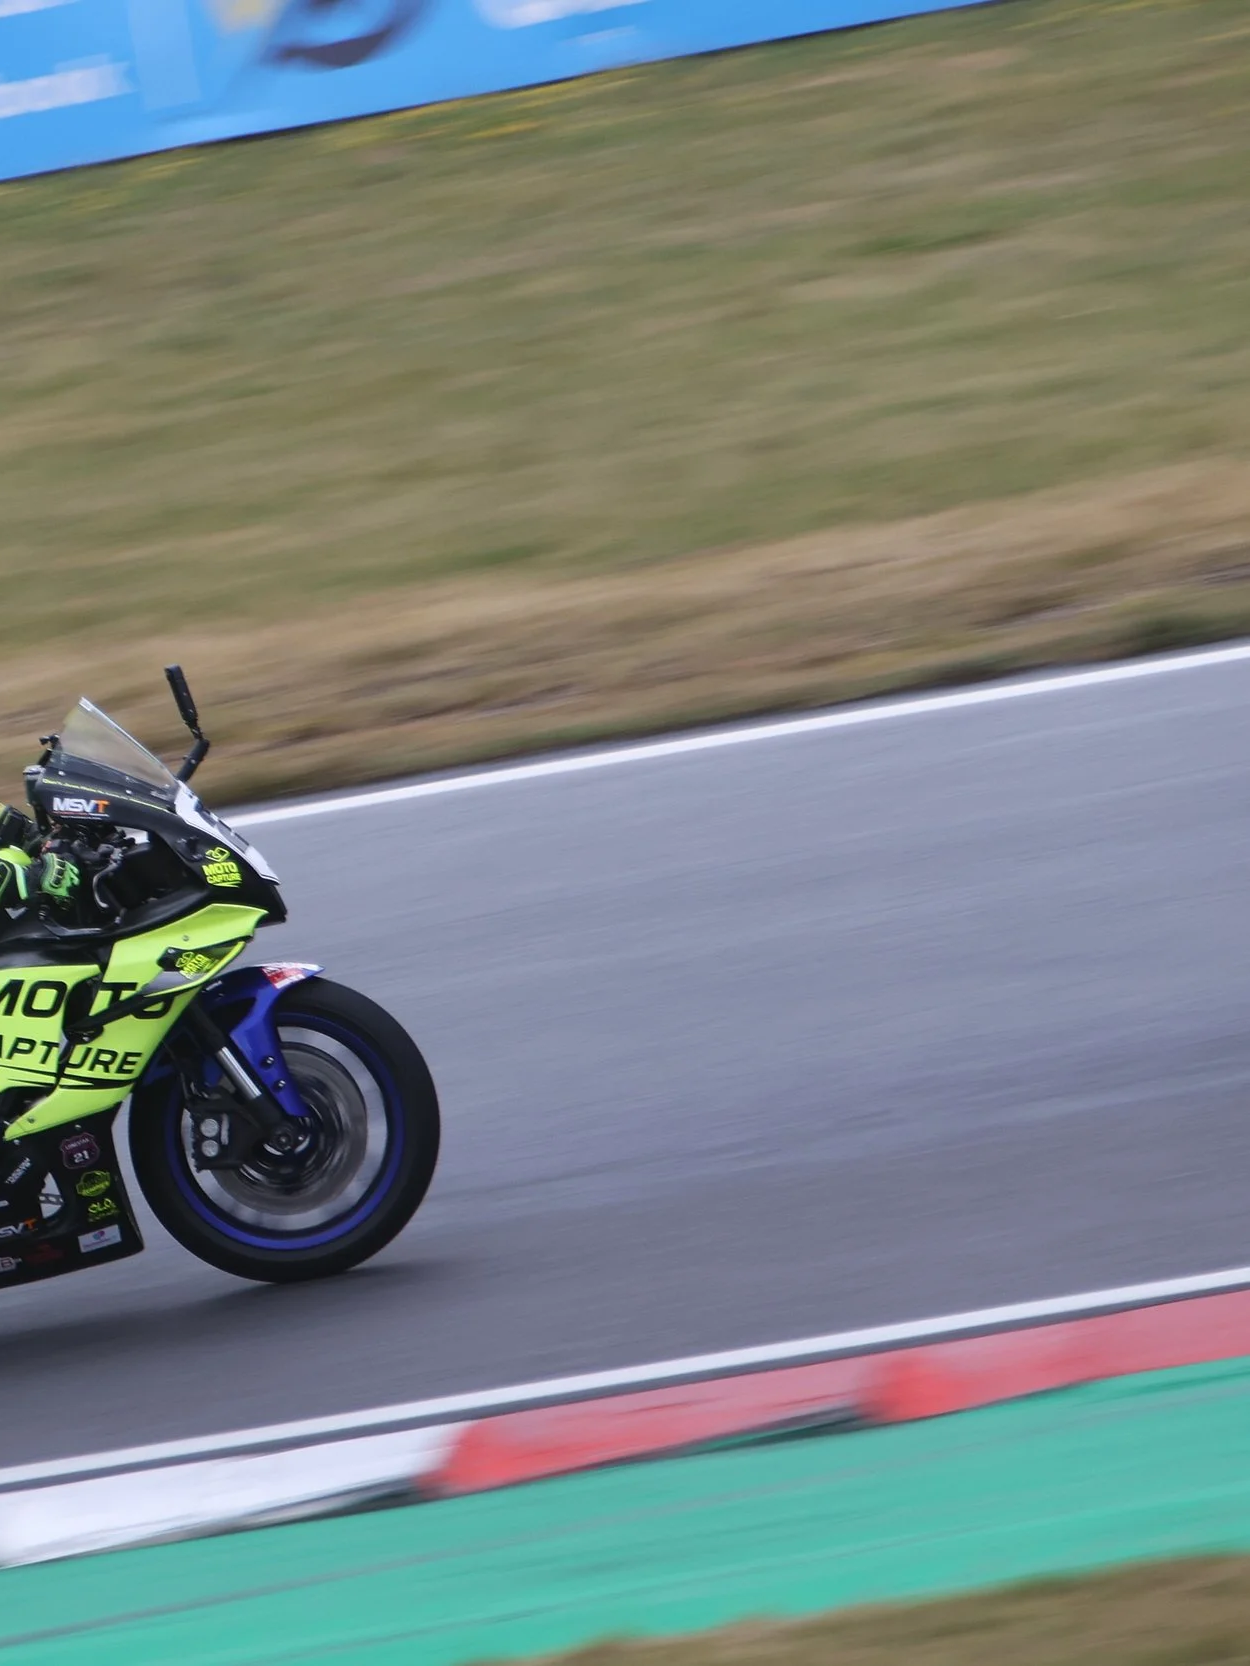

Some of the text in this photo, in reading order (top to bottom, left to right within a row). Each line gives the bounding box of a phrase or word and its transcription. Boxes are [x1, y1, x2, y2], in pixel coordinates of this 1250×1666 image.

[53, 797, 110, 813] MSVT
[202, 861, 239, 876] MOTO
[207, 872, 242, 884] CAPTURE
[74, 1150, 90, 1163] 21
